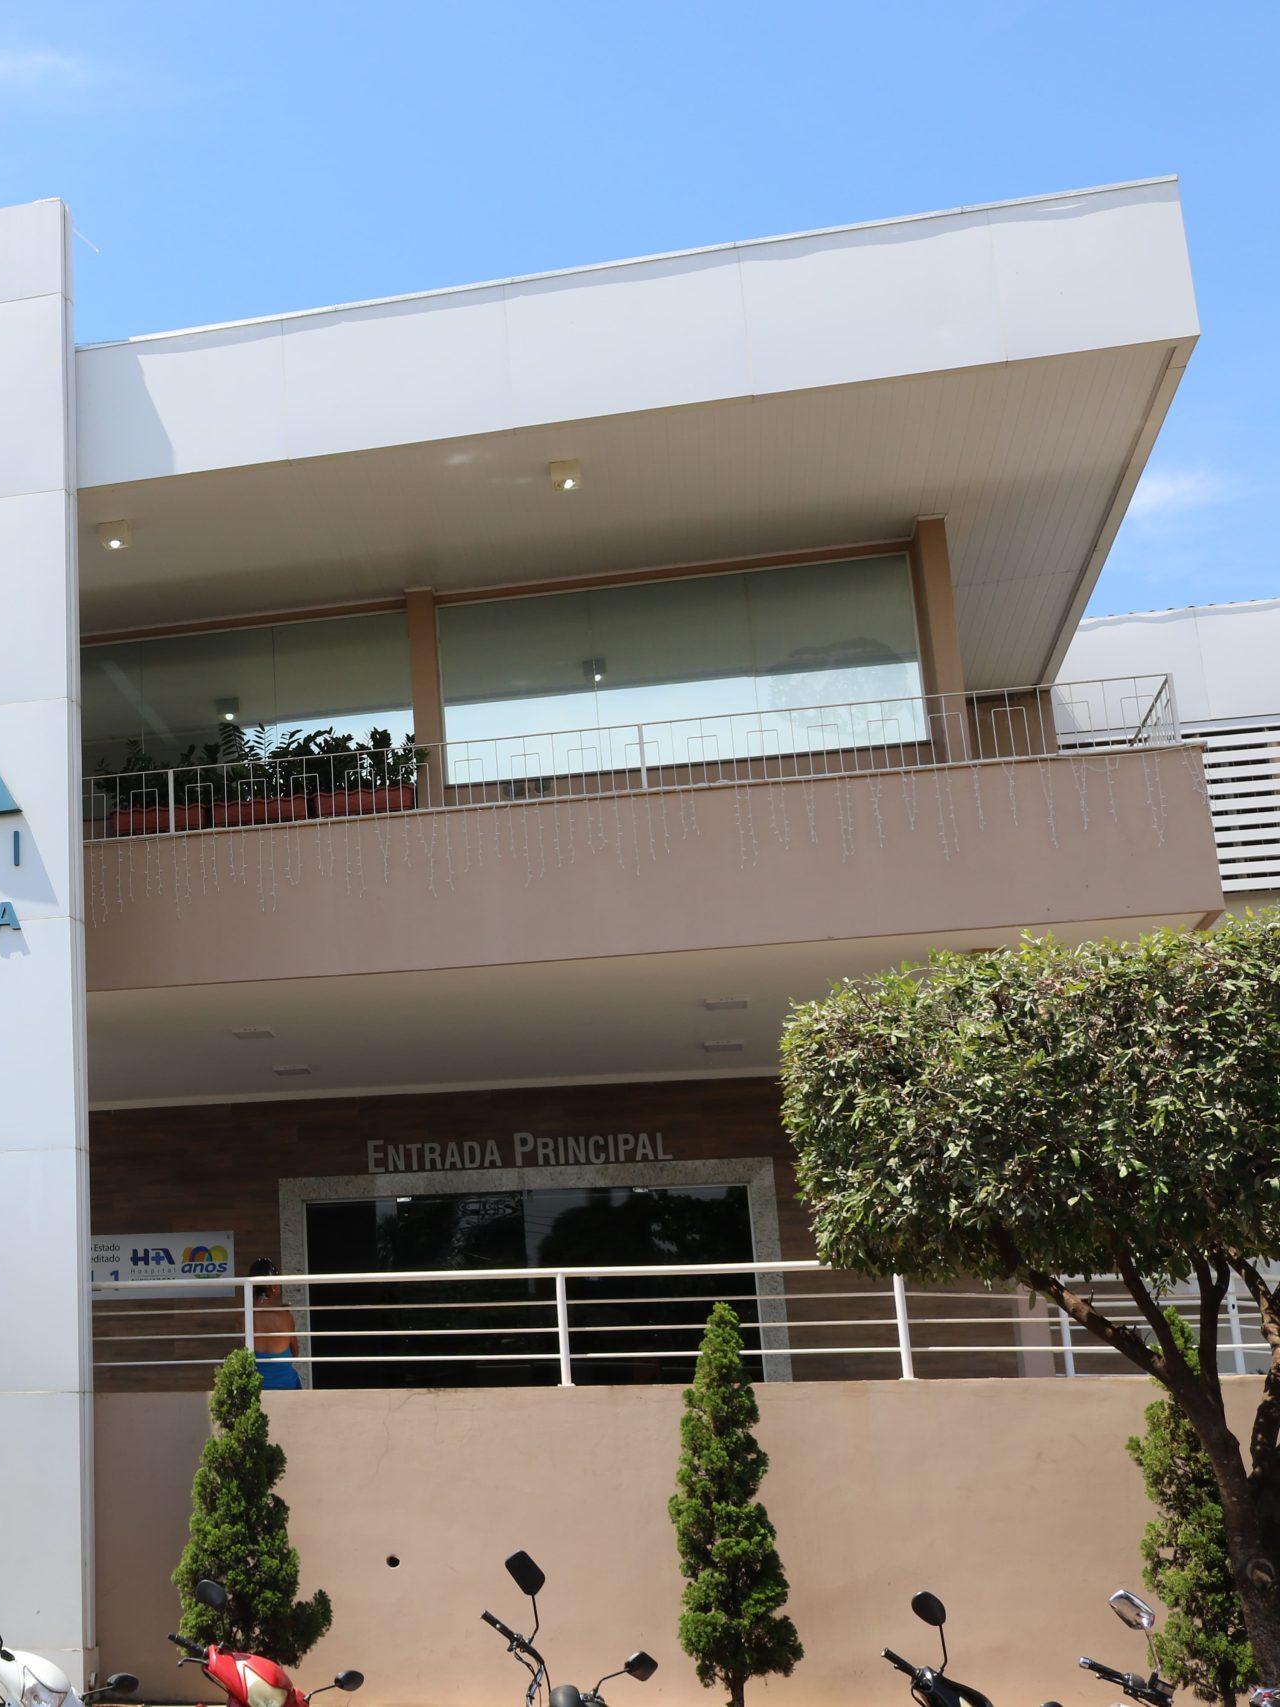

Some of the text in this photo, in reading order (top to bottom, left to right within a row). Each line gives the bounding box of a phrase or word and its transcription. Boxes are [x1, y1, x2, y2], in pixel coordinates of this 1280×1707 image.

[367, 1132, 672, 1174] ENTRADA PRINCIPAL
[94, 1243, 120, 1252] Estado
[130, 1267, 176, 1275] Hospital
[181, 1262, 228, 1273] anos
